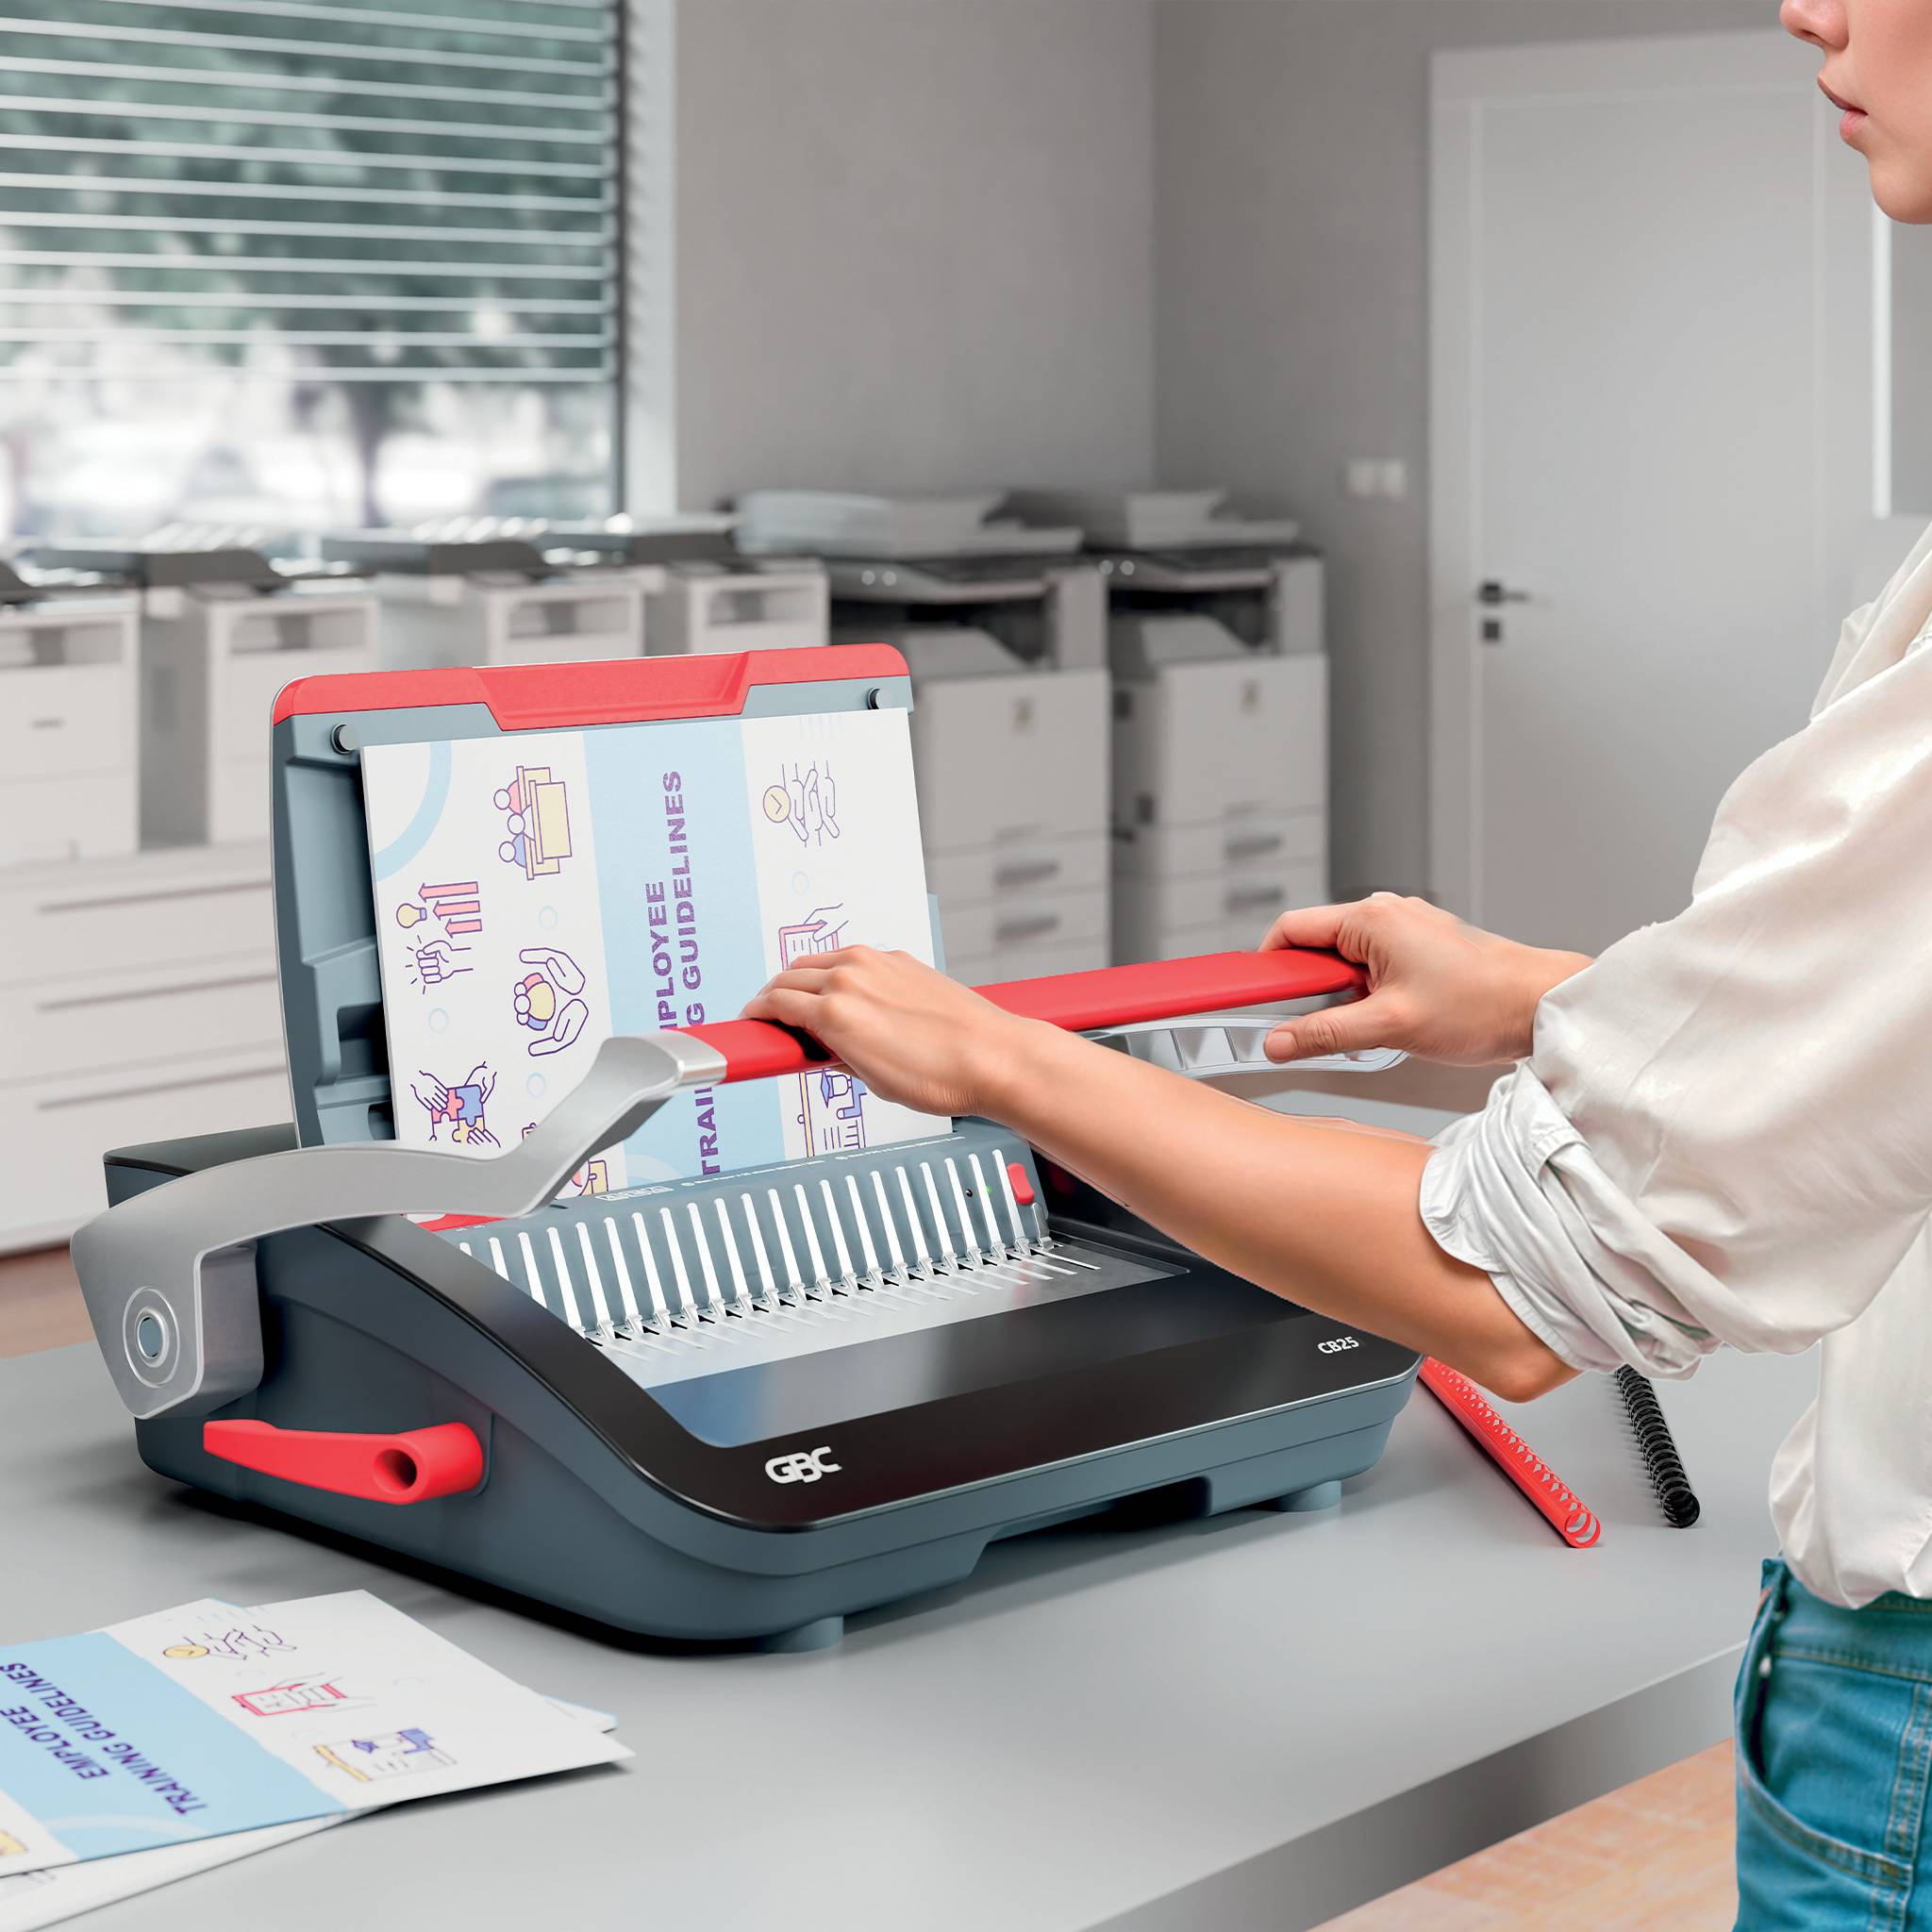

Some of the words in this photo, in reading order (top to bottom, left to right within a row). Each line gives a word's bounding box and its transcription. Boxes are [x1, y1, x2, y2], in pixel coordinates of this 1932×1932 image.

[663, 771, 702, 991] GUIDELINES
[645, 881, 678, 1028] PLOYEE
[1317, 1336, 1359, 1354] CB25
[765, 1446, 842, 1484] GBC
[0, 1662, 116, 1741] GUIDELINES
[0, 1706, 109, 1779] EMPLOYEE
[102, 1741, 208, 1814] TRAINING
